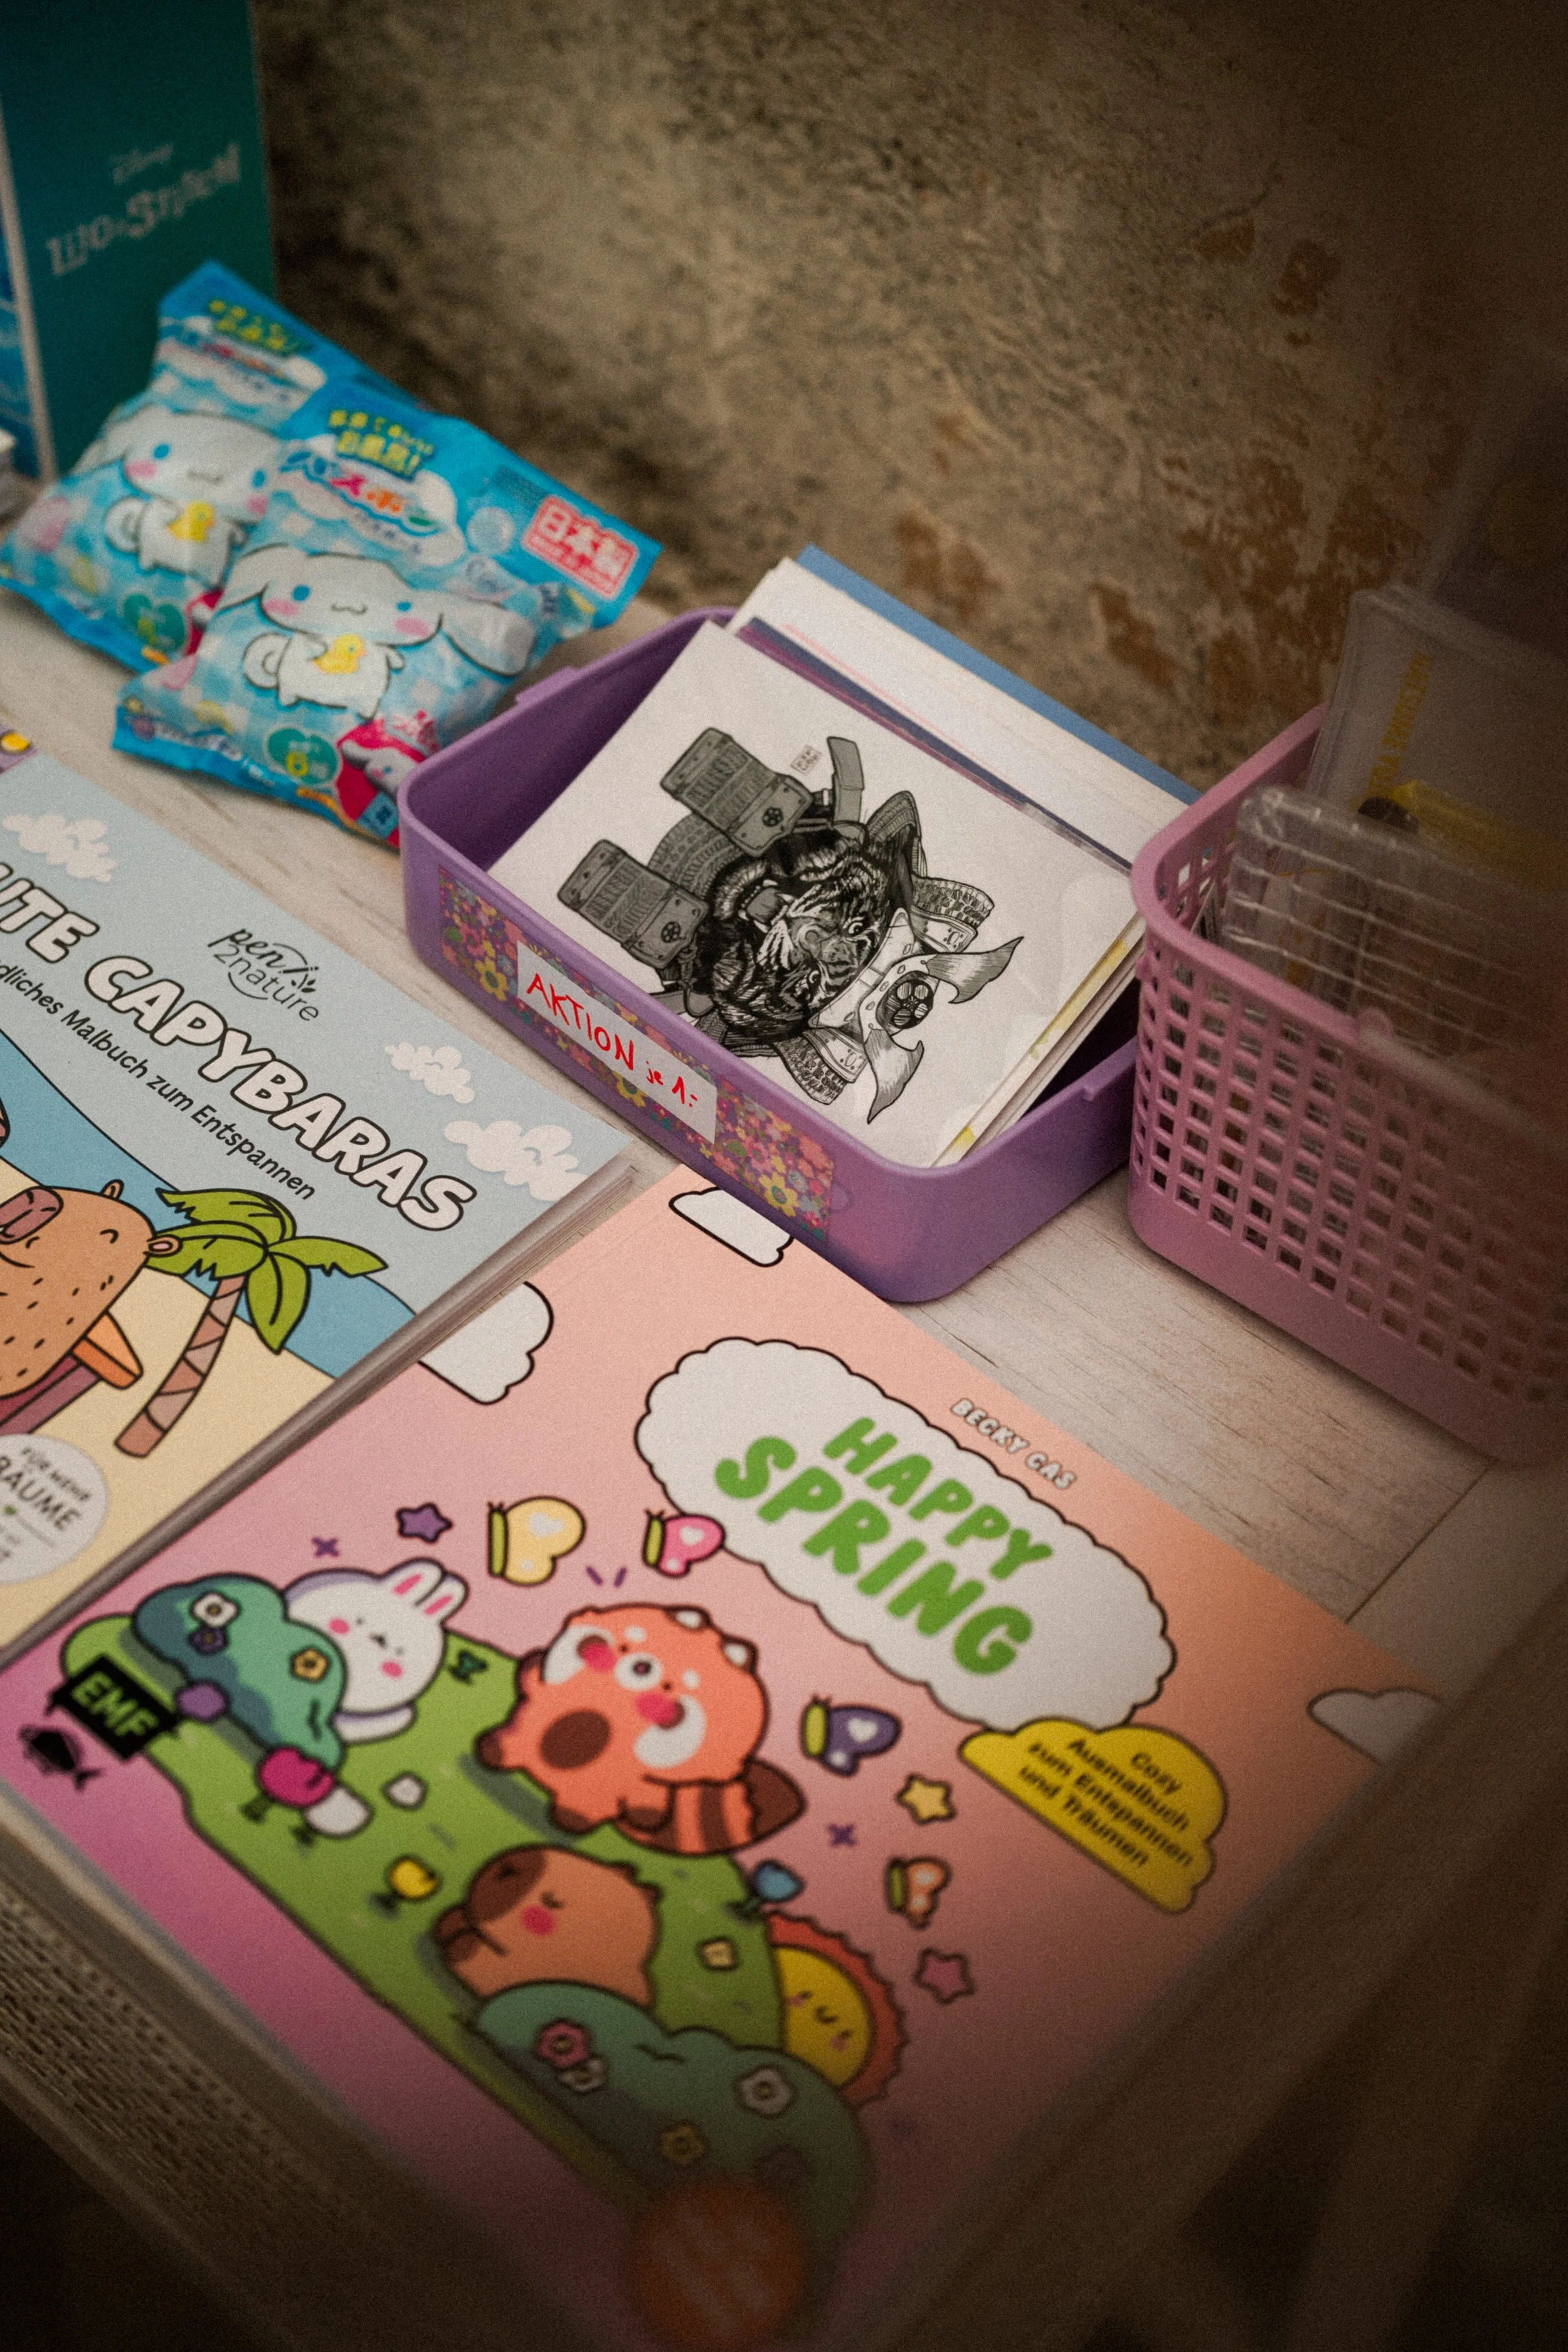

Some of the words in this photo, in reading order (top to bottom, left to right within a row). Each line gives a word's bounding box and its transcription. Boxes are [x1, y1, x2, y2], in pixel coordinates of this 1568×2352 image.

[527, 973, 634, 1071] AKTION
[646, 1061, 664, 1085] je
[61, 1009, 149, 1079] Malbuch
[146, 1075, 194, 1112] zum
[191, 1104, 315, 1199] Entspannen
[84, 955, 477, 1231] CAPYBARAS
[822, 1416, 1053, 1581] HAPPY
[950, 1398, 1029, 1455] BECKY
[1024, 1450, 1077, 1490] CAS
[714, 1435, 1033, 1675] SPRING
[71, 1671, 160, 1739] EMF
[1019, 1766, 1062, 1800] und
[1027, 1742, 1072, 1777] zum
[1074, 1772, 1193, 1867] Entspannen
[1068, 1738, 1190, 1833] Ausmalbuch
[1131, 1752, 1182, 1796] Cozy
